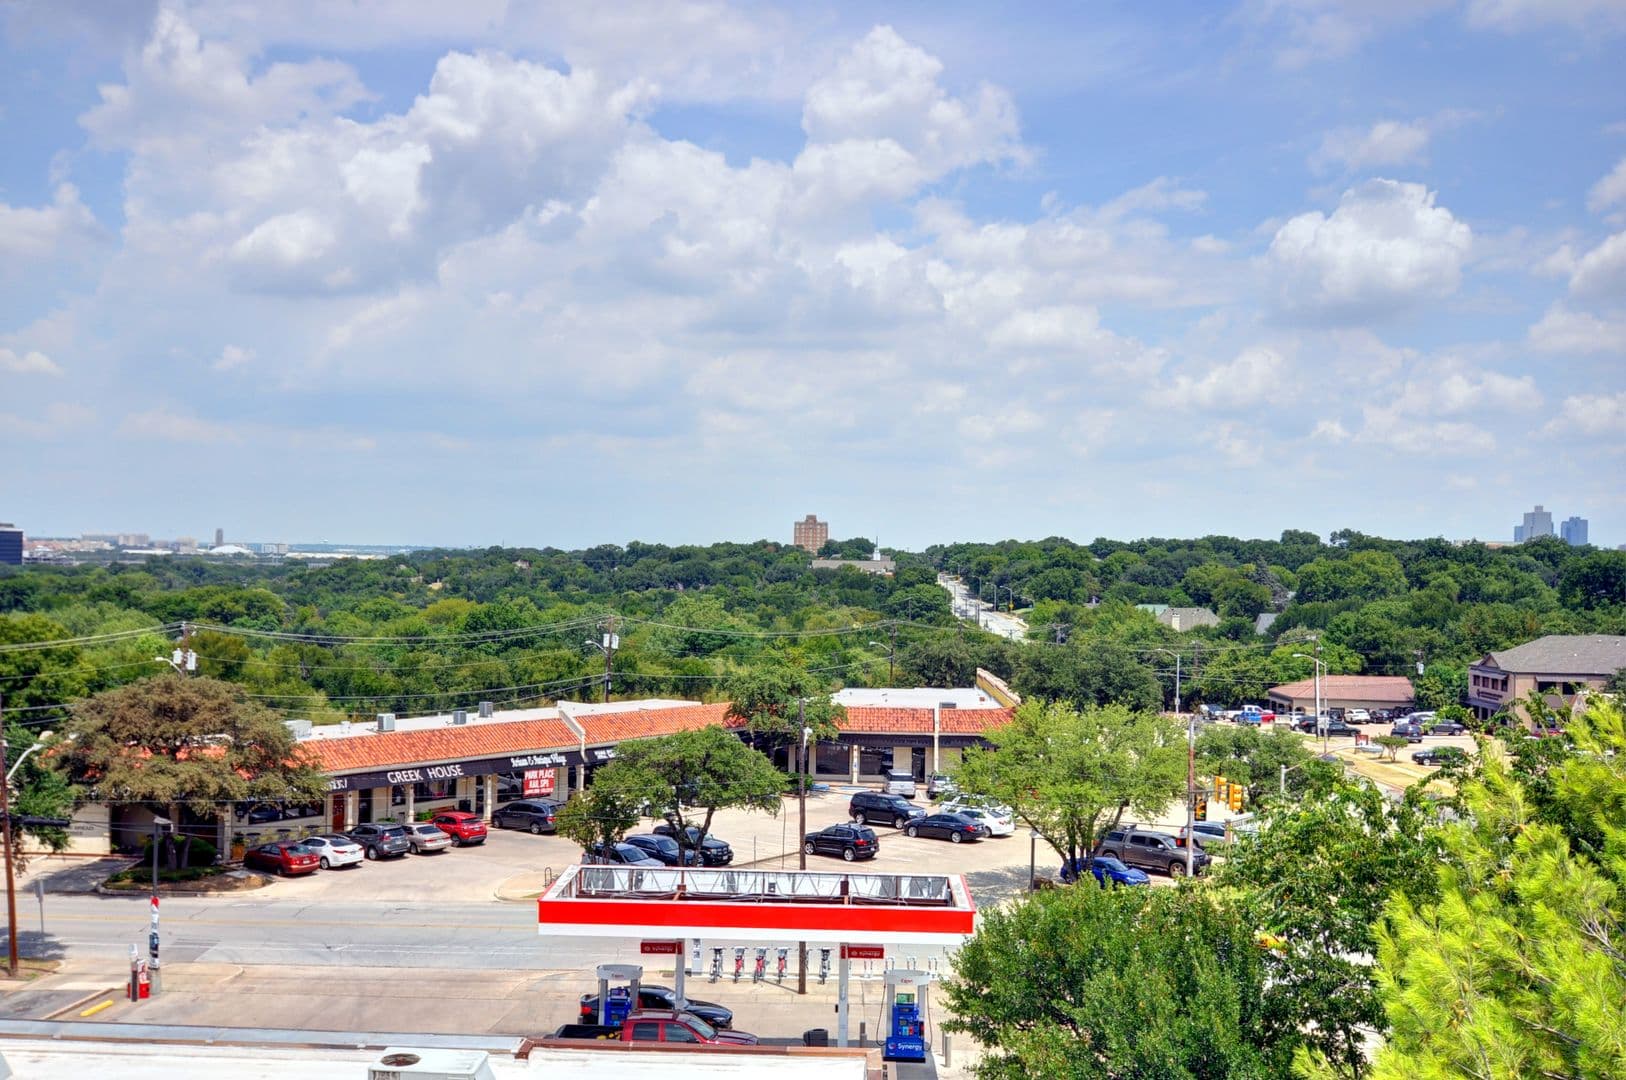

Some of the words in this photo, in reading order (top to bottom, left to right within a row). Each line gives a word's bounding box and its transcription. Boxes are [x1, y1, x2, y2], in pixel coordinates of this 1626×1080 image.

[387, 769, 424, 784] GREEK
[427, 764, 465, 779] HOUSE
[525, 770, 538, 780] PARK
[539, 768, 555, 779] PLACE
[897, 1042, 922, 1051] Synergy
